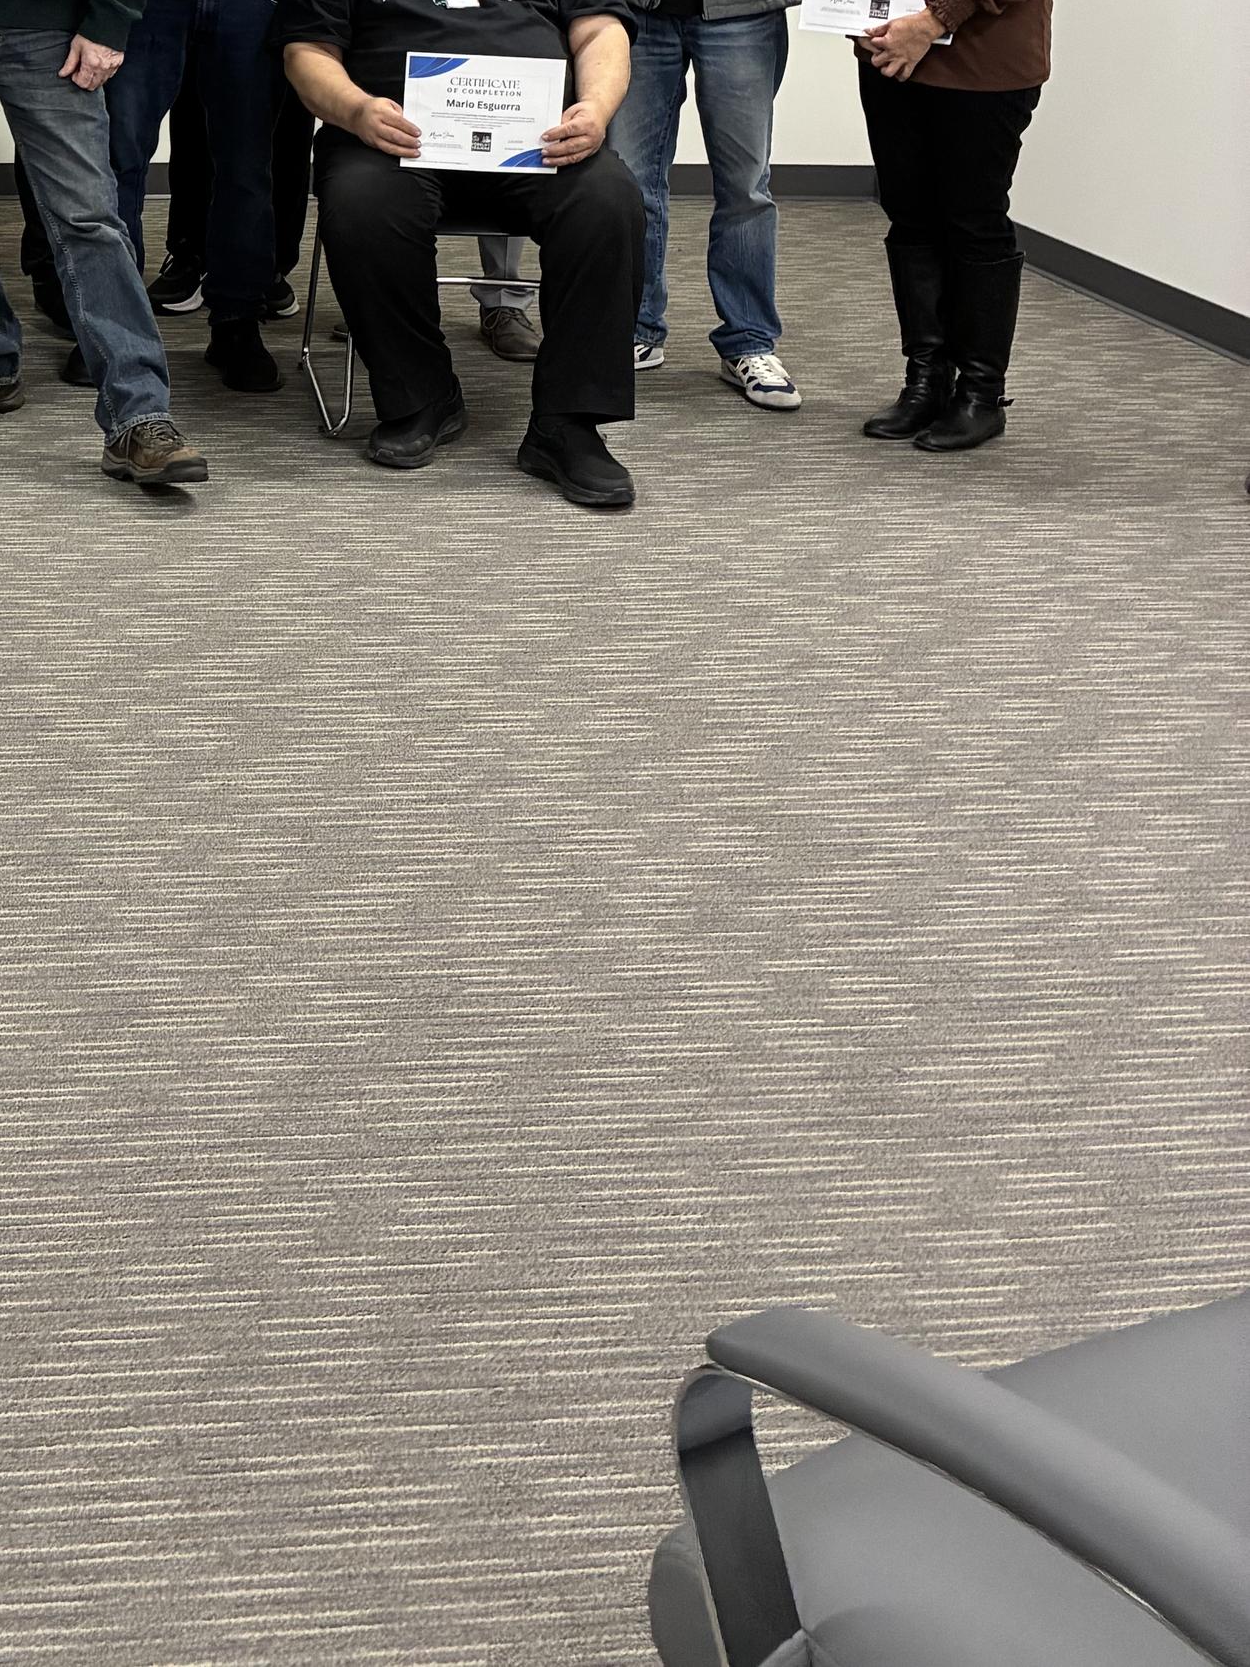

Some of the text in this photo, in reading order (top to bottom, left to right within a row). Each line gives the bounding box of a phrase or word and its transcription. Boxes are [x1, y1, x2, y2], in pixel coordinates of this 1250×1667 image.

[450, 76, 520, 89] CERTIFICATE
[462, 88, 522, 97] COMPLETION
[446, 100, 521, 112] Mario Esguerra
